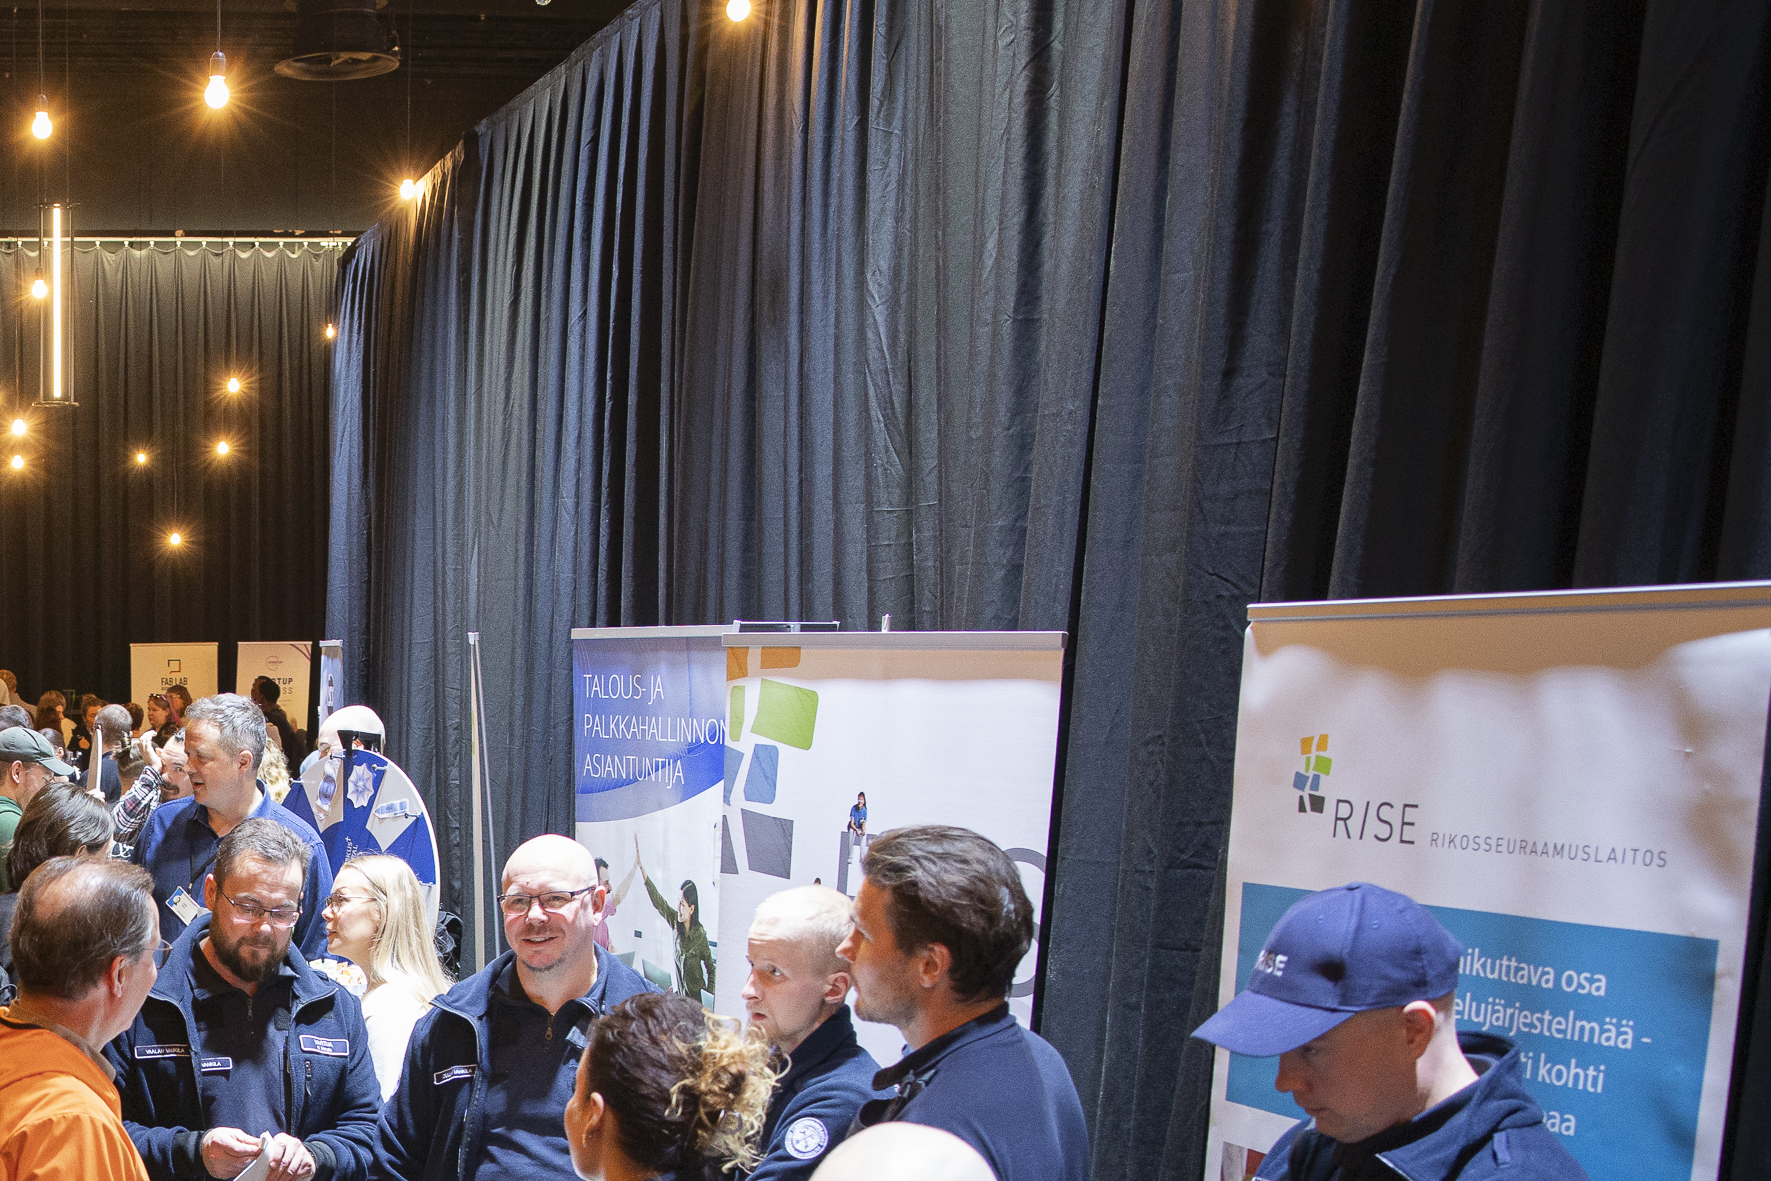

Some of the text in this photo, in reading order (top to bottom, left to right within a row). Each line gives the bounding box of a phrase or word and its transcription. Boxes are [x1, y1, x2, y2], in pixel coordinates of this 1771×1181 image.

[161, 677, 173, 686] FAB
[583, 674, 664, 705] TALOUS- JA
[583, 753, 685, 789] ASIANTUNTIJA
[1332, 799, 1420, 845] RISE
[1430, 832, 1668, 868] RIKOSSEURAAMUSLAITOS
[1561, 969, 1607, 996] osa
[1537, 1053, 1606, 1093] kohti
